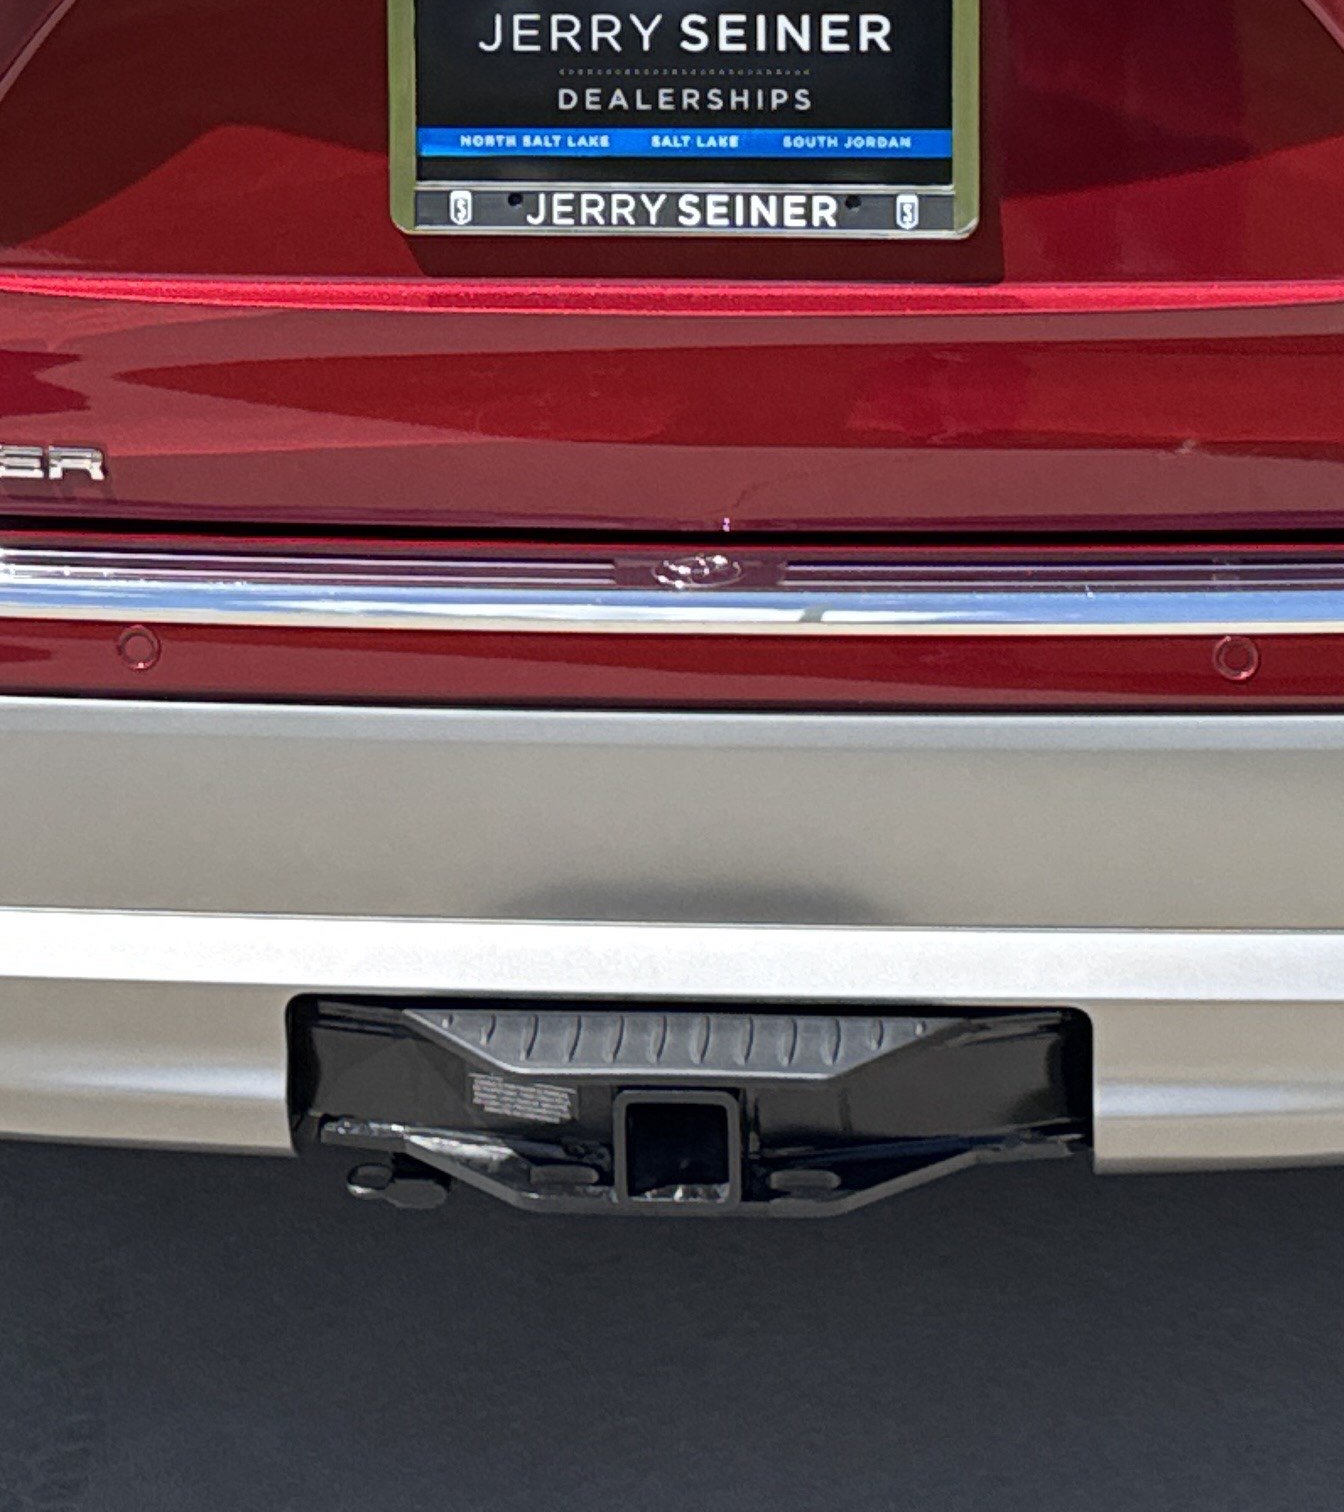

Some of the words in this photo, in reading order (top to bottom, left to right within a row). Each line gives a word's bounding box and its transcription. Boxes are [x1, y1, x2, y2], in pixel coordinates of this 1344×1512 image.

[478, 13, 663, 53] JERRY
[680, 13, 891, 53] SEINER
[558, 87, 812, 111] DEALERSHIPS
[460, 134, 516, 149] NORTH
[523, 134, 561, 149] SALT
[567, 134, 609, 149] LAKE
[651, 134, 690, 149] SALT
[697, 134, 738, 149] LAKE
[783, 134, 837, 149] SOUTH
[844, 134, 911, 149] JORDAN
[526, 193, 668, 227] JERRY
[676, 193, 838, 229] SEINER
